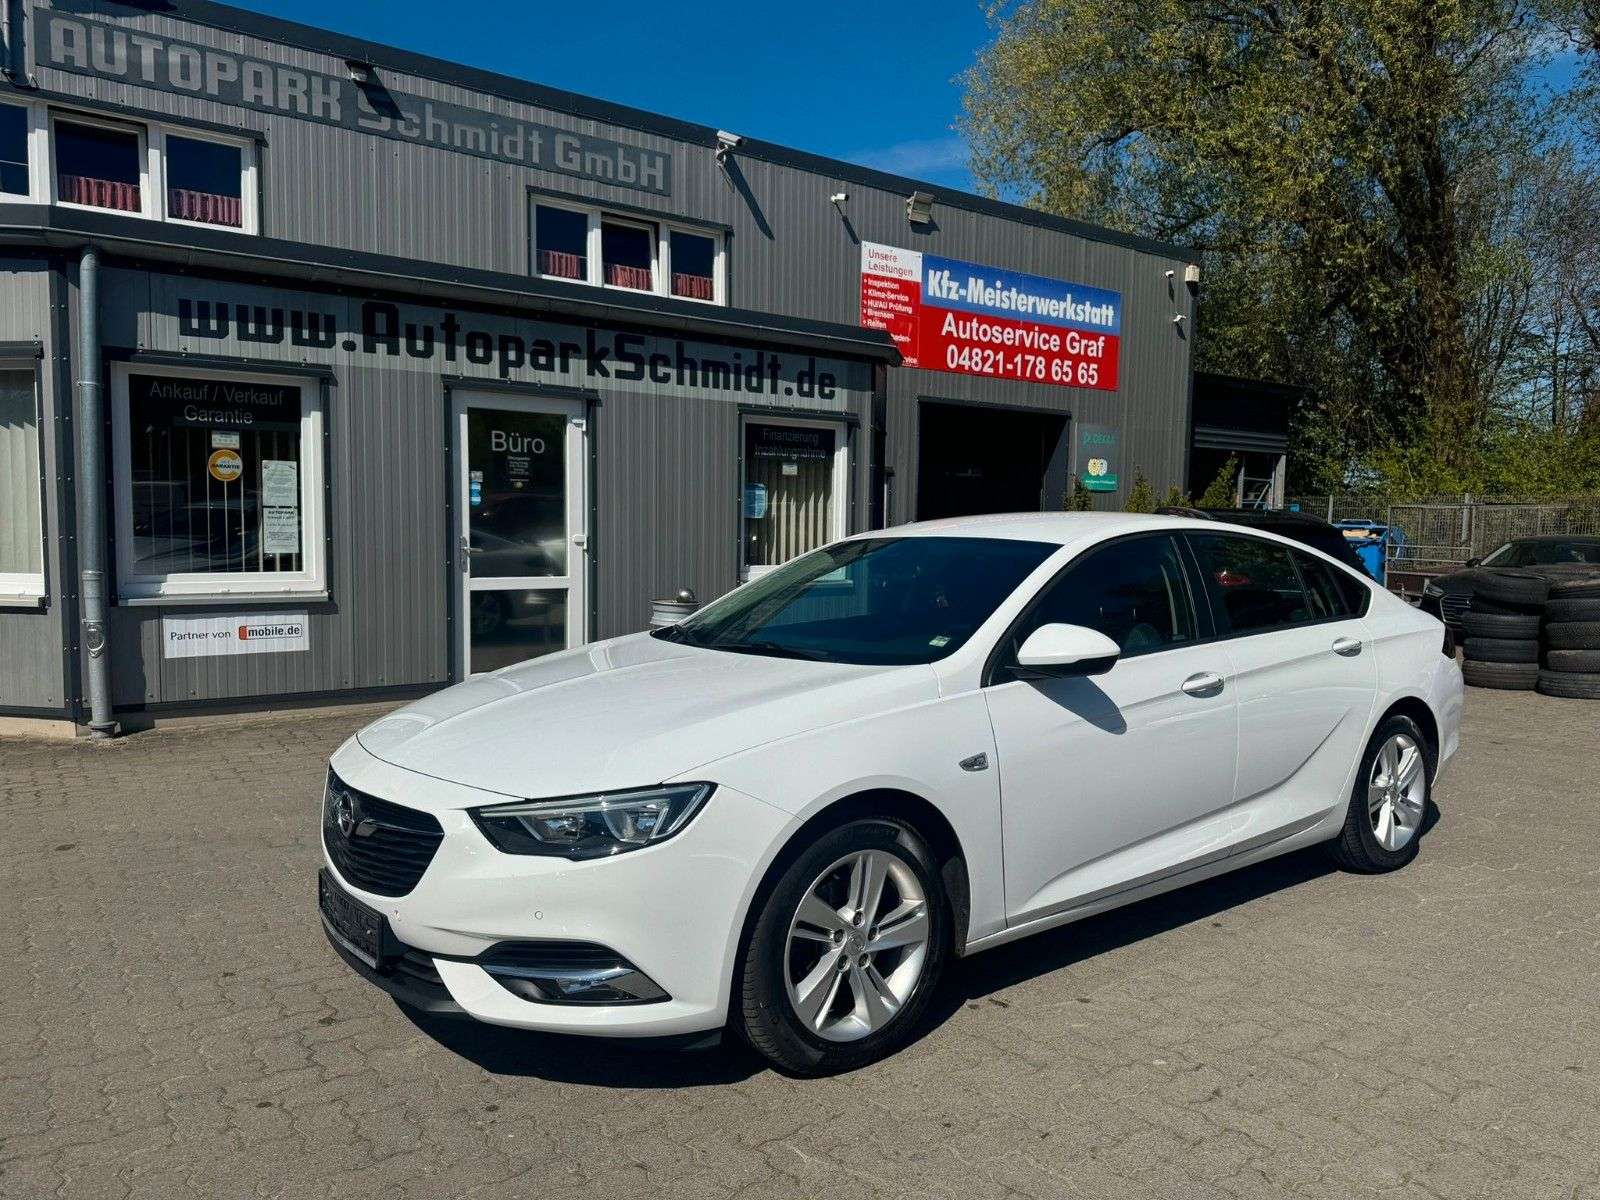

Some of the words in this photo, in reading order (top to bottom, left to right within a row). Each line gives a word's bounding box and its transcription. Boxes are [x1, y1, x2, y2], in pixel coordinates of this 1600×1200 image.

[50, 17, 342, 122] AUTOPARK
[357, 93, 543, 164] Schmidt
[555, 132, 664, 190] GmbH
[868, 248, 898, 263] Unsere
[868, 261, 913, 278] Leistungen
[867, 278, 900, 290] Inspektion
[927, 269, 1115, 327] Kfz-Meisterwerkstatt
[940, 312, 1061, 352] Autoservice
[1065, 331, 1106, 358] Graf
[178, 299, 837, 400] www.AutoparkSchmidt.de
[946, 344, 1046, 380] 04821-178
[1051, 359, 1073, 383] 65
[1077, 362, 1099, 386] 65
[150, 380, 209, 402] Ankauf
[224, 386, 285, 407] Verkauf
[184, 404, 253, 425] Garantie
[491, 430, 545, 454] Büro
[762, 427, 819, 446] Finanzierung
[170, 630, 209, 642] Partner
[212, 630, 231, 641] von
[248, 625, 301, 638] mobile.de
